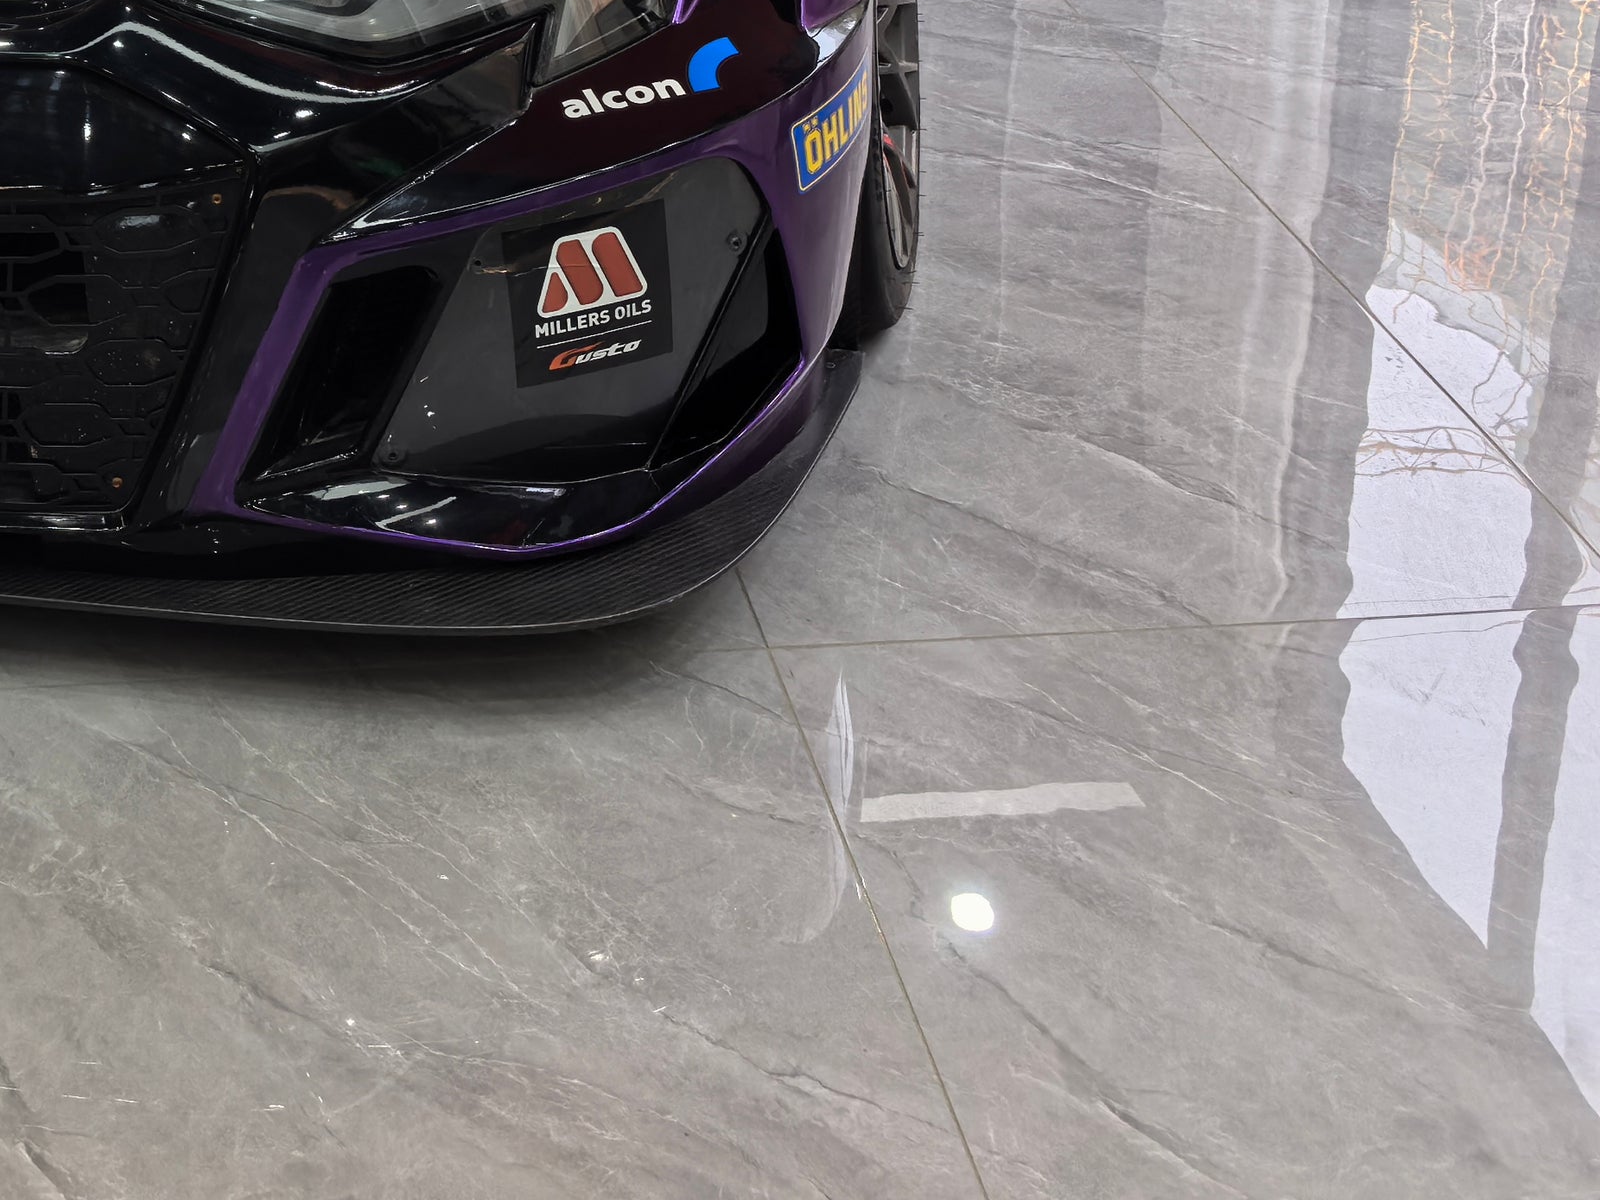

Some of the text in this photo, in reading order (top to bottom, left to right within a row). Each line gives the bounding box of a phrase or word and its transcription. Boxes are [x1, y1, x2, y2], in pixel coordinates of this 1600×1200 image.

[561, 78, 688, 119] alcon
[534, 299, 652, 339] MILLERS OILS
[549, 340, 642, 371] Gusto
